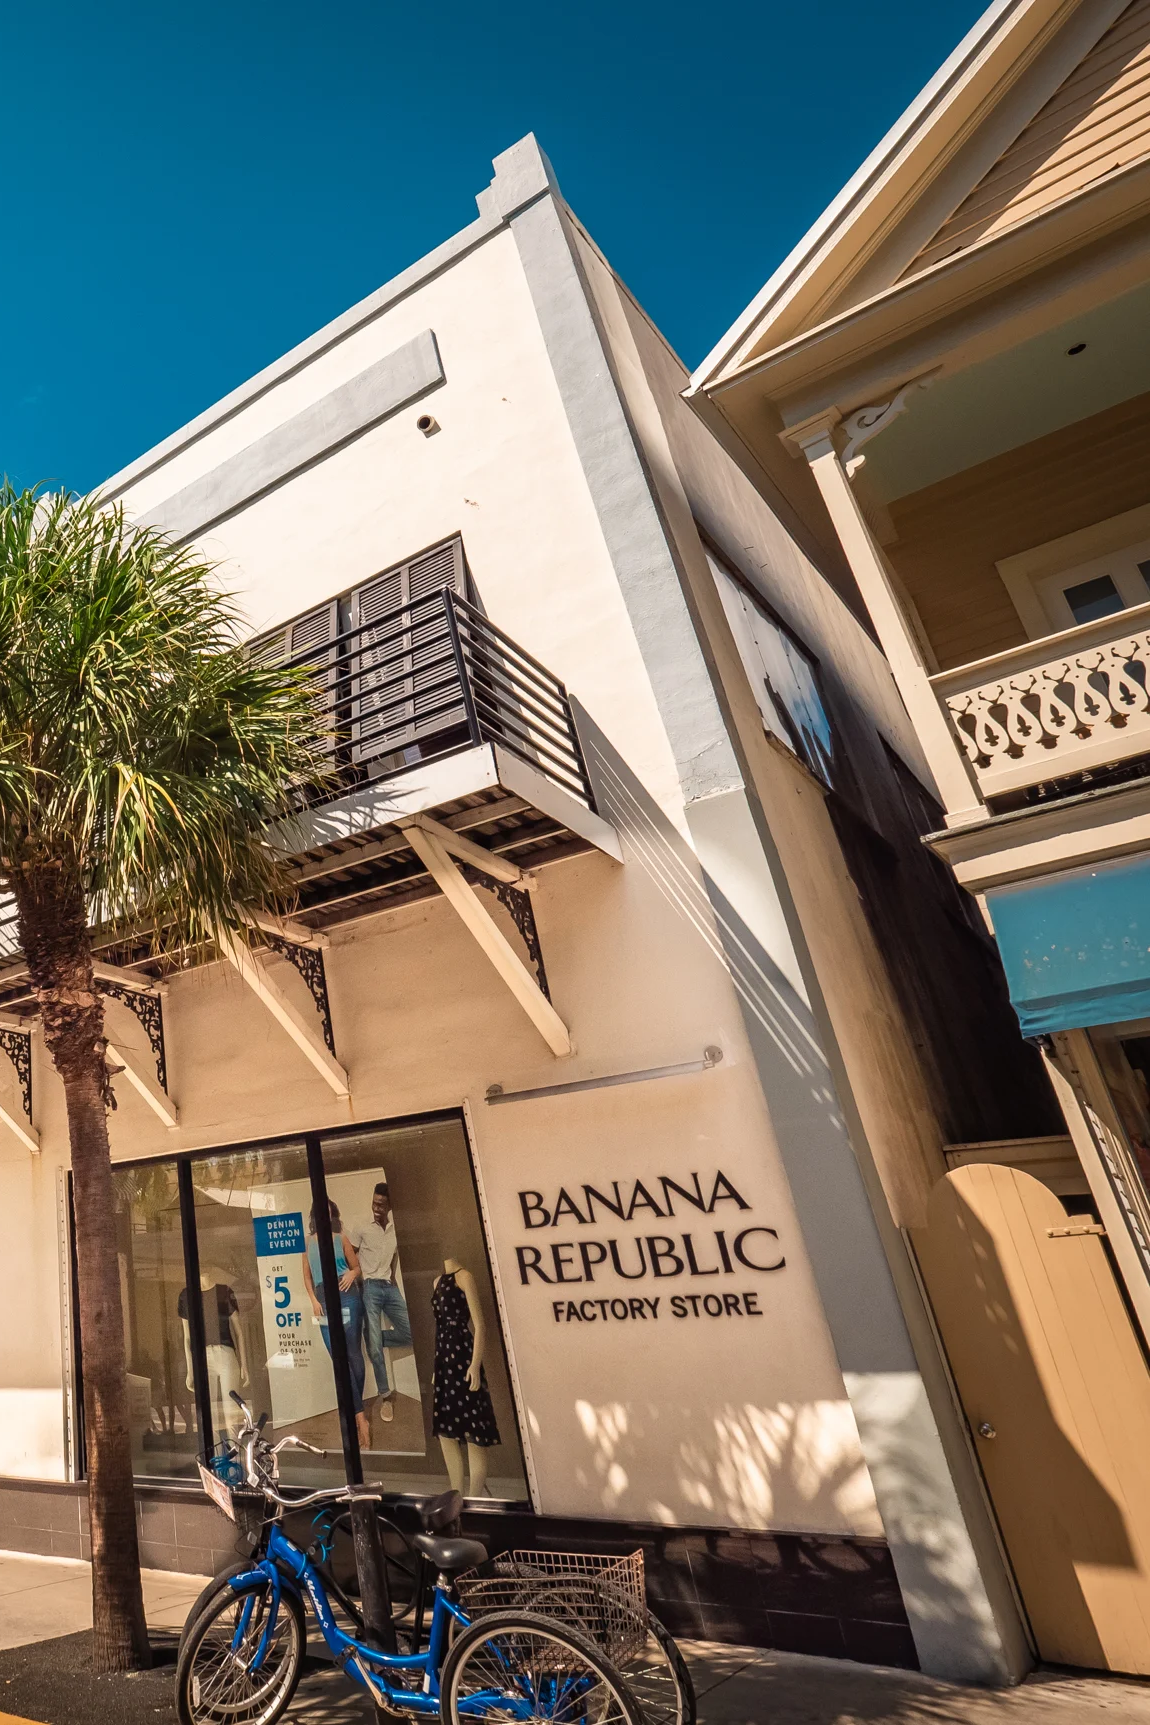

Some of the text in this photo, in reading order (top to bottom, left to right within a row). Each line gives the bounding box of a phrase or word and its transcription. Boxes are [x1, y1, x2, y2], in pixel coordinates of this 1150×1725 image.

[517, 1169, 753, 1229] BANANA
[267, 1219, 296, 1230] DENIM
[268, 1228, 300, 1239] TRY-ON
[269, 1239, 296, 1249] EVENT
[514, 1227, 787, 1286] REPUBLIC
[552, 1292, 763, 1323] FACTORY STORE
[275, 1312, 302, 1328] OFF
